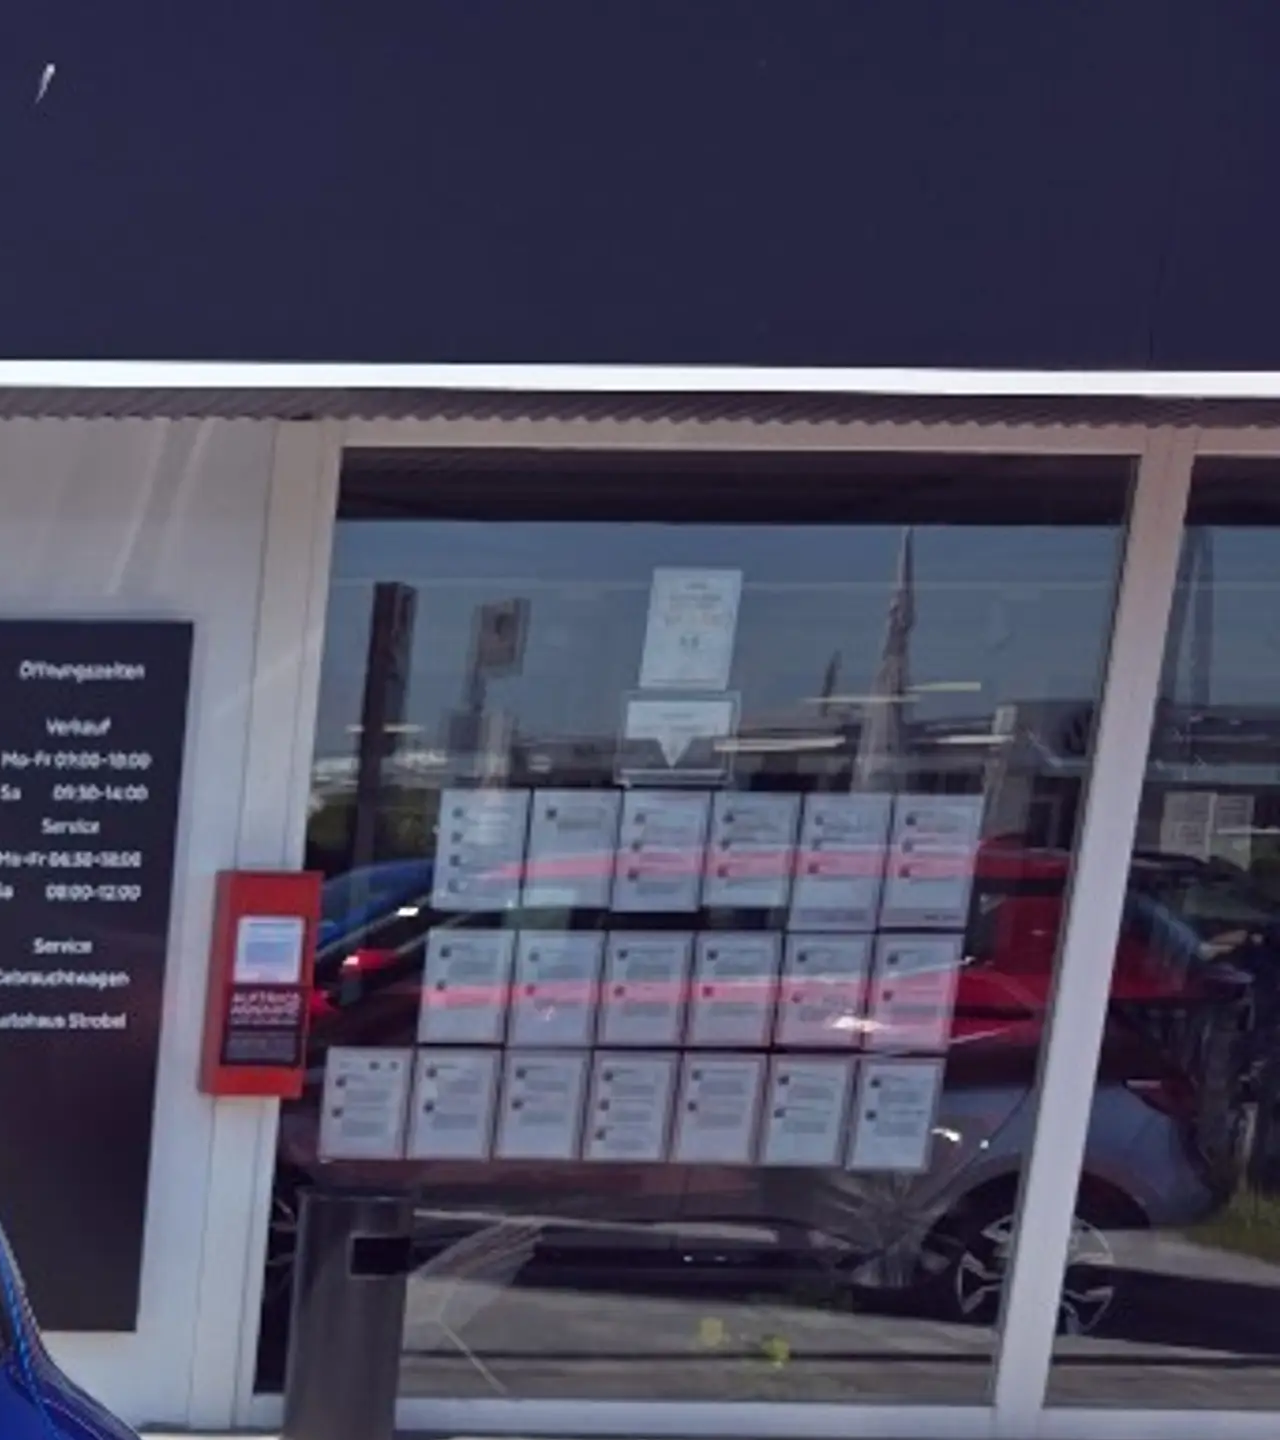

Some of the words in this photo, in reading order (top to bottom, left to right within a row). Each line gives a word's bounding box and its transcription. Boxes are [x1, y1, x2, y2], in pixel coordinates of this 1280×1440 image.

[19, 660, 146, 684] Öffnungszeiten
[46, 717, 111, 736] Verkauf
[0, 783, 22, 800] Sa
[42, 817, 100, 835] Service
[33, 937, 93, 954] Service
[68, 1012, 127, 1029] Strobel
